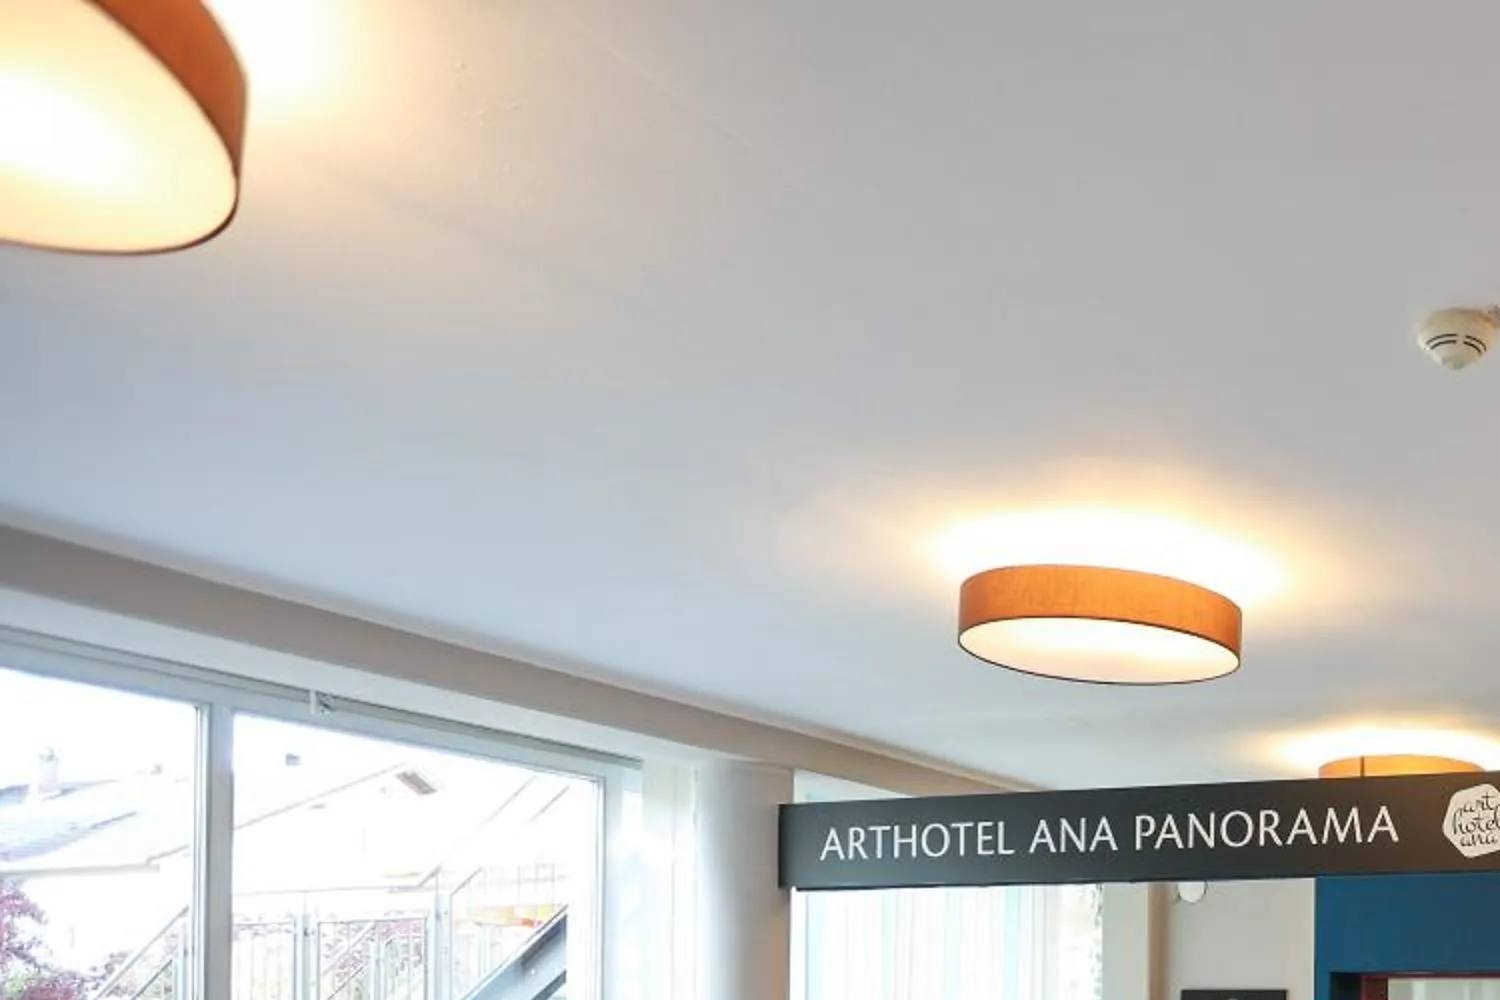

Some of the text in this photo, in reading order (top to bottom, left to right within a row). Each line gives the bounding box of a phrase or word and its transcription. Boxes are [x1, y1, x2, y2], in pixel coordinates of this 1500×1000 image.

[1463, 792, 1497, 812] art
[819, 806, 1399, 861] ARTHOTEL ANA PANORAMA
